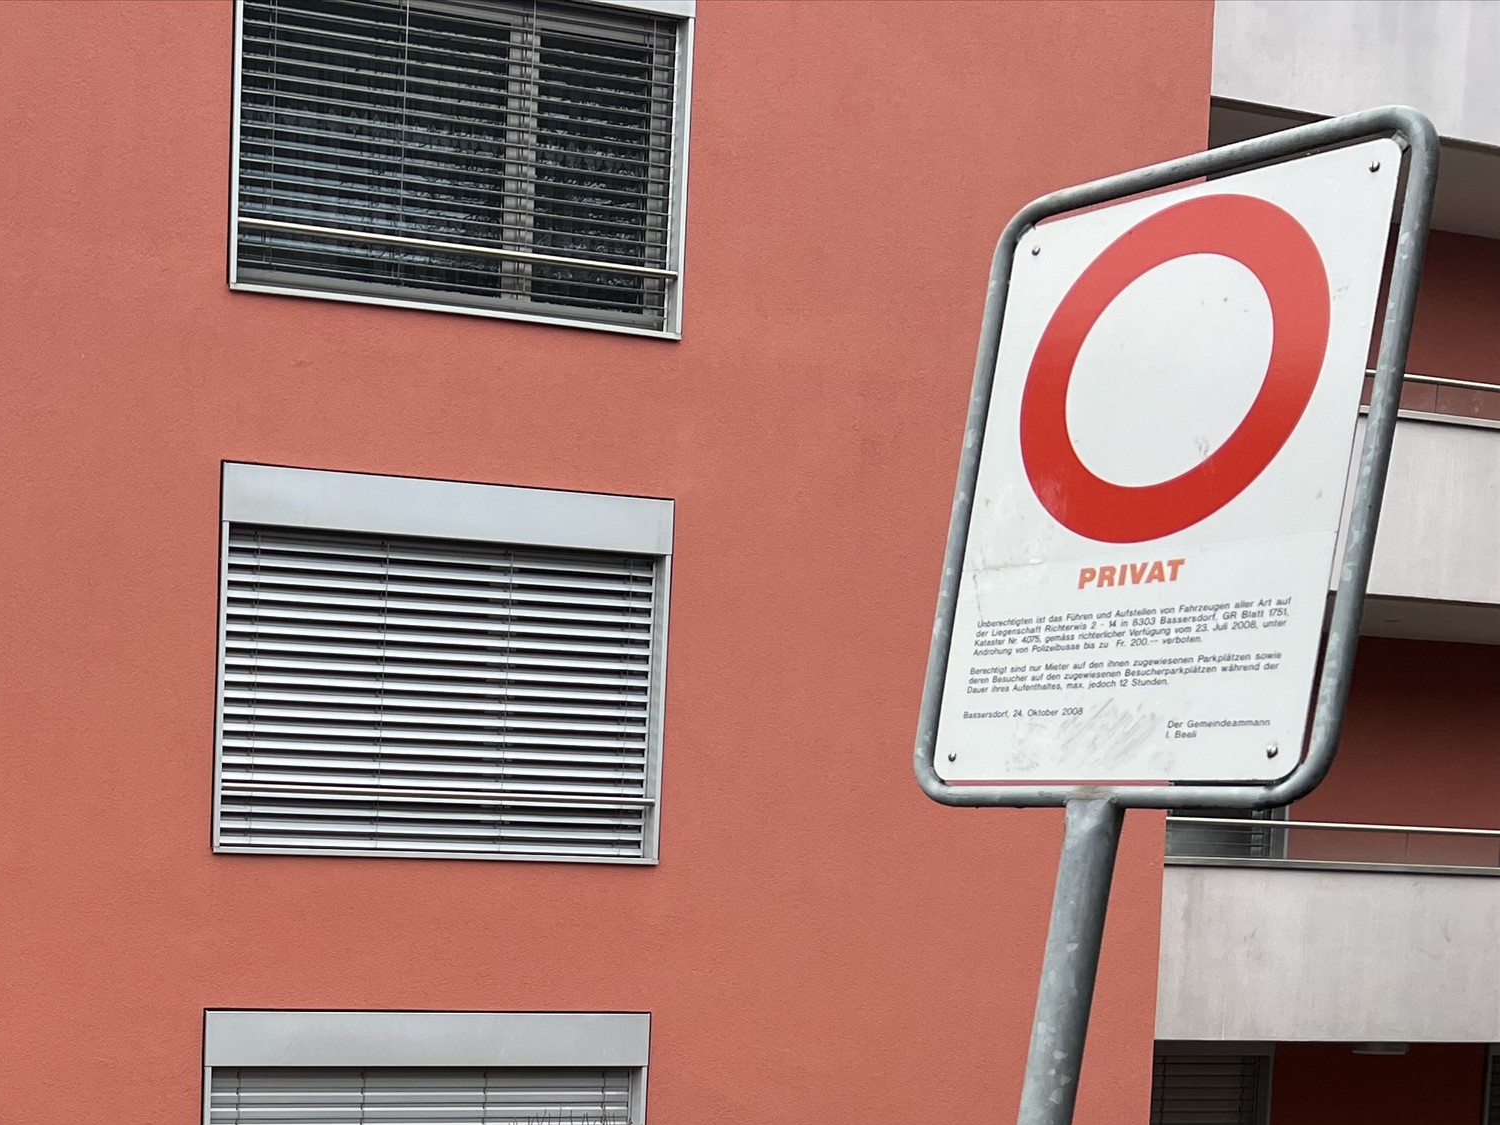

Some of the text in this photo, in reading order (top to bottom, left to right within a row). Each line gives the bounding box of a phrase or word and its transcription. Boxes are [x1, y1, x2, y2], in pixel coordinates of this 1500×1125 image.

[1078, 558, 1185, 590] PRIVAT
[977, 617, 1033, 628] Unberechtigten
[1049, 615, 1062, 623] das
[1066, 613, 1093, 621] Führen
[1097, 611, 1112, 619] und
[1115, 608, 1156, 617] Aufstellen
[1179, 603, 1230, 613] Fahrzeugen
[1258, 599, 1272, 607] Art
[1276, 596, 1292, 605] auf
[974, 638, 1005, 646] Kataster
[1045, 635, 1075, 643] gemäss
[1078, 631, 1125, 639] richterlicher
[1129, 627, 1171, 636] Verfügung
[1213, 623, 1228, 631] Juli
[1263, 619, 1287, 627] unter
[976, 630, 989, 638] der
[992, 626, 1041, 637] Liegenschaft
[1045, 623, 1087, 632] Richterwis
[1132, 617, 1155, 626] 8303
[1242, 610, 1264, 618] Blatt
[973, 647, 1012, 656] Androhung
[1032, 643, 1080, 652] Polizeibusse
[970, 666, 1007, 675] Berechtigt
[1045, 662, 1069, 670] Mieter
[1073, 661, 1086, 669] auf
[1133, 656, 1194, 667] zugewiesenen
[1198, 653, 1251, 663] Parkplätzen
[1255, 651, 1282, 660] sowie
[992, 674, 1028, 683] Besucher
[1064, 670, 1121, 680] zugewiesenen
[1125, 665, 1217, 676] Besucherparkplätzen
[1221, 663, 1260, 671] während
[1264, 662, 1280, 670] der
[967, 685, 988, 694] Dauer
[991, 684, 1010, 692] ihres
[1088, 680, 1116, 689] jedoch
[1120, 679, 1128, 687] 12
[1028, 709, 1059, 717] Oktober
[1062, 707, 1084, 716] 2008
[1167, 718, 1270, 728] Der Gemeindeammann
